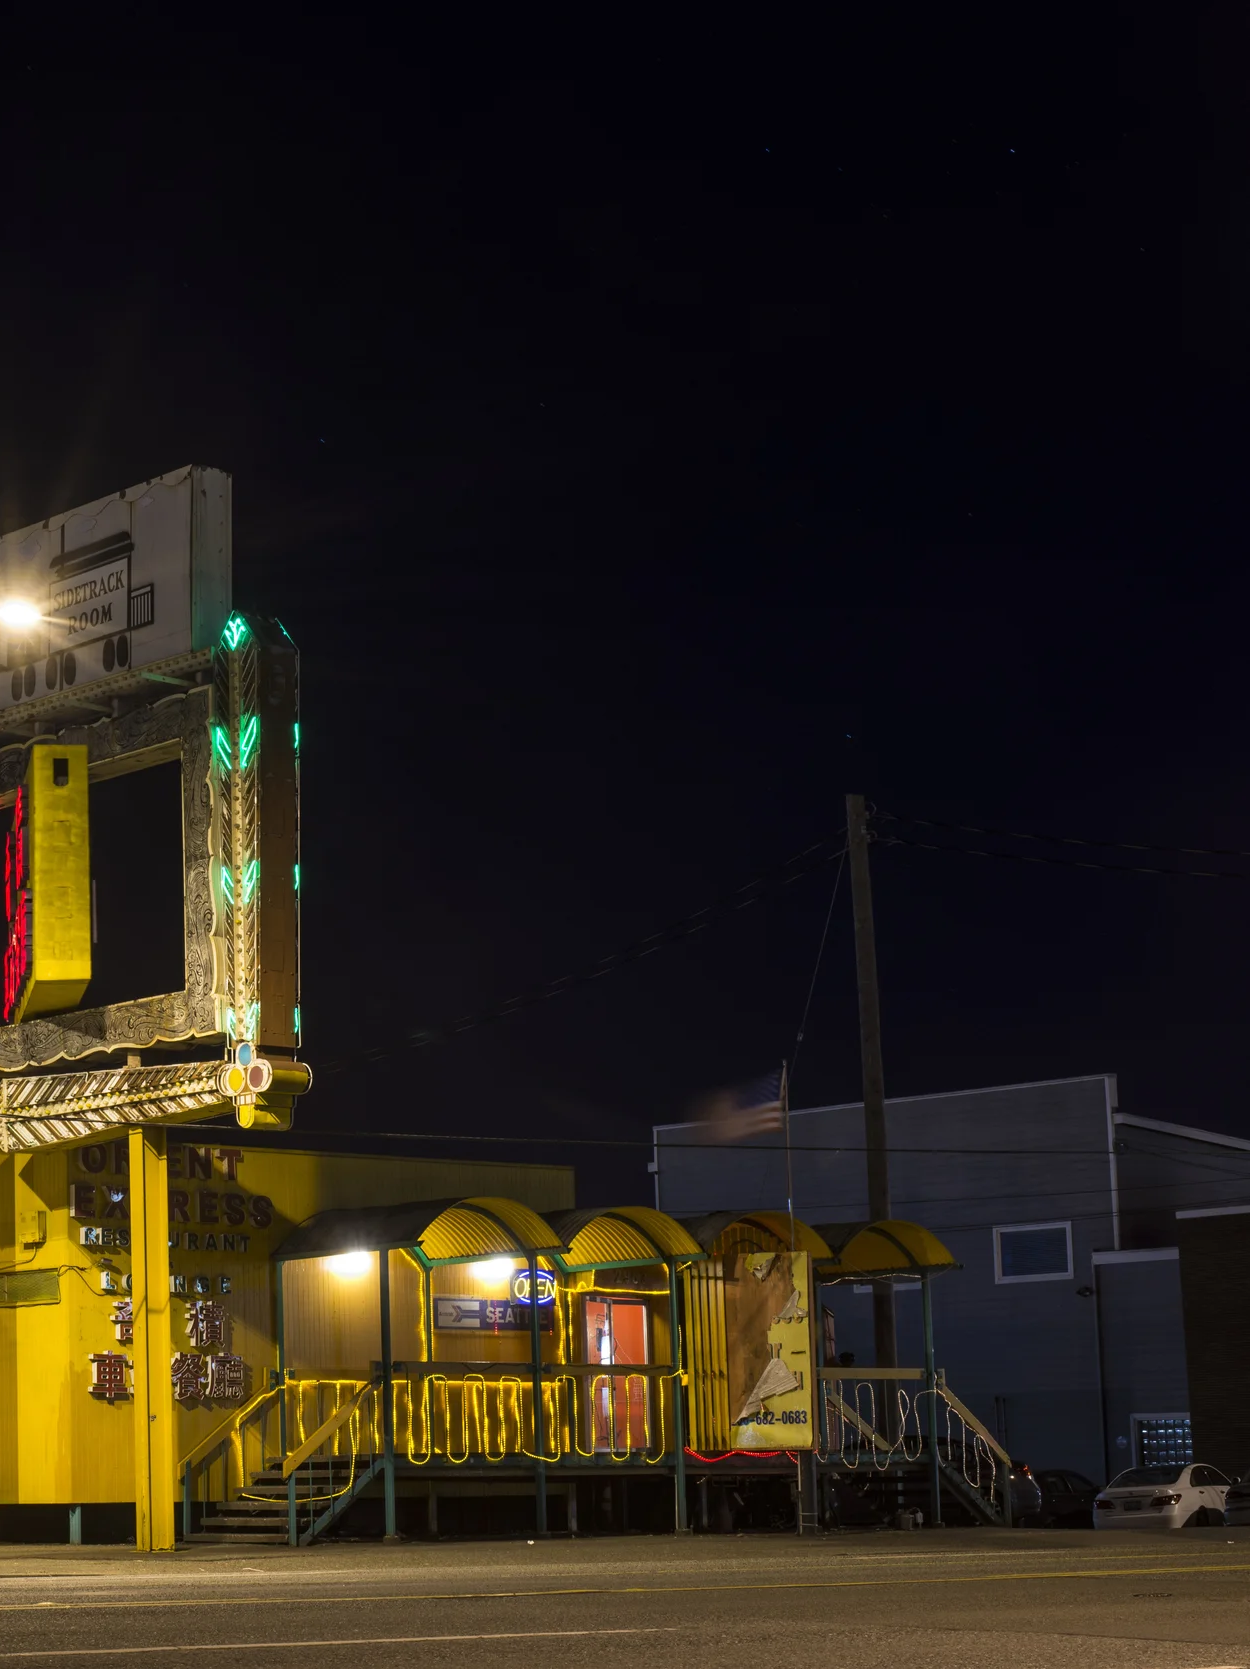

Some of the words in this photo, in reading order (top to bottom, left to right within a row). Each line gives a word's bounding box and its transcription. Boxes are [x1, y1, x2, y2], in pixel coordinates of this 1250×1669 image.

[54, 570, 125, 612] SIDETRACK
[68, 603, 113, 636] ROOM
[80, 1144, 243, 1181] ORENT
[70, 1184, 273, 1229] EXRESS
[80, 1226, 251, 1253] RESURANT
[486, 1306, 549, 1325] SEATTE
[88, 1350, 244, 1401] 車餐廳
